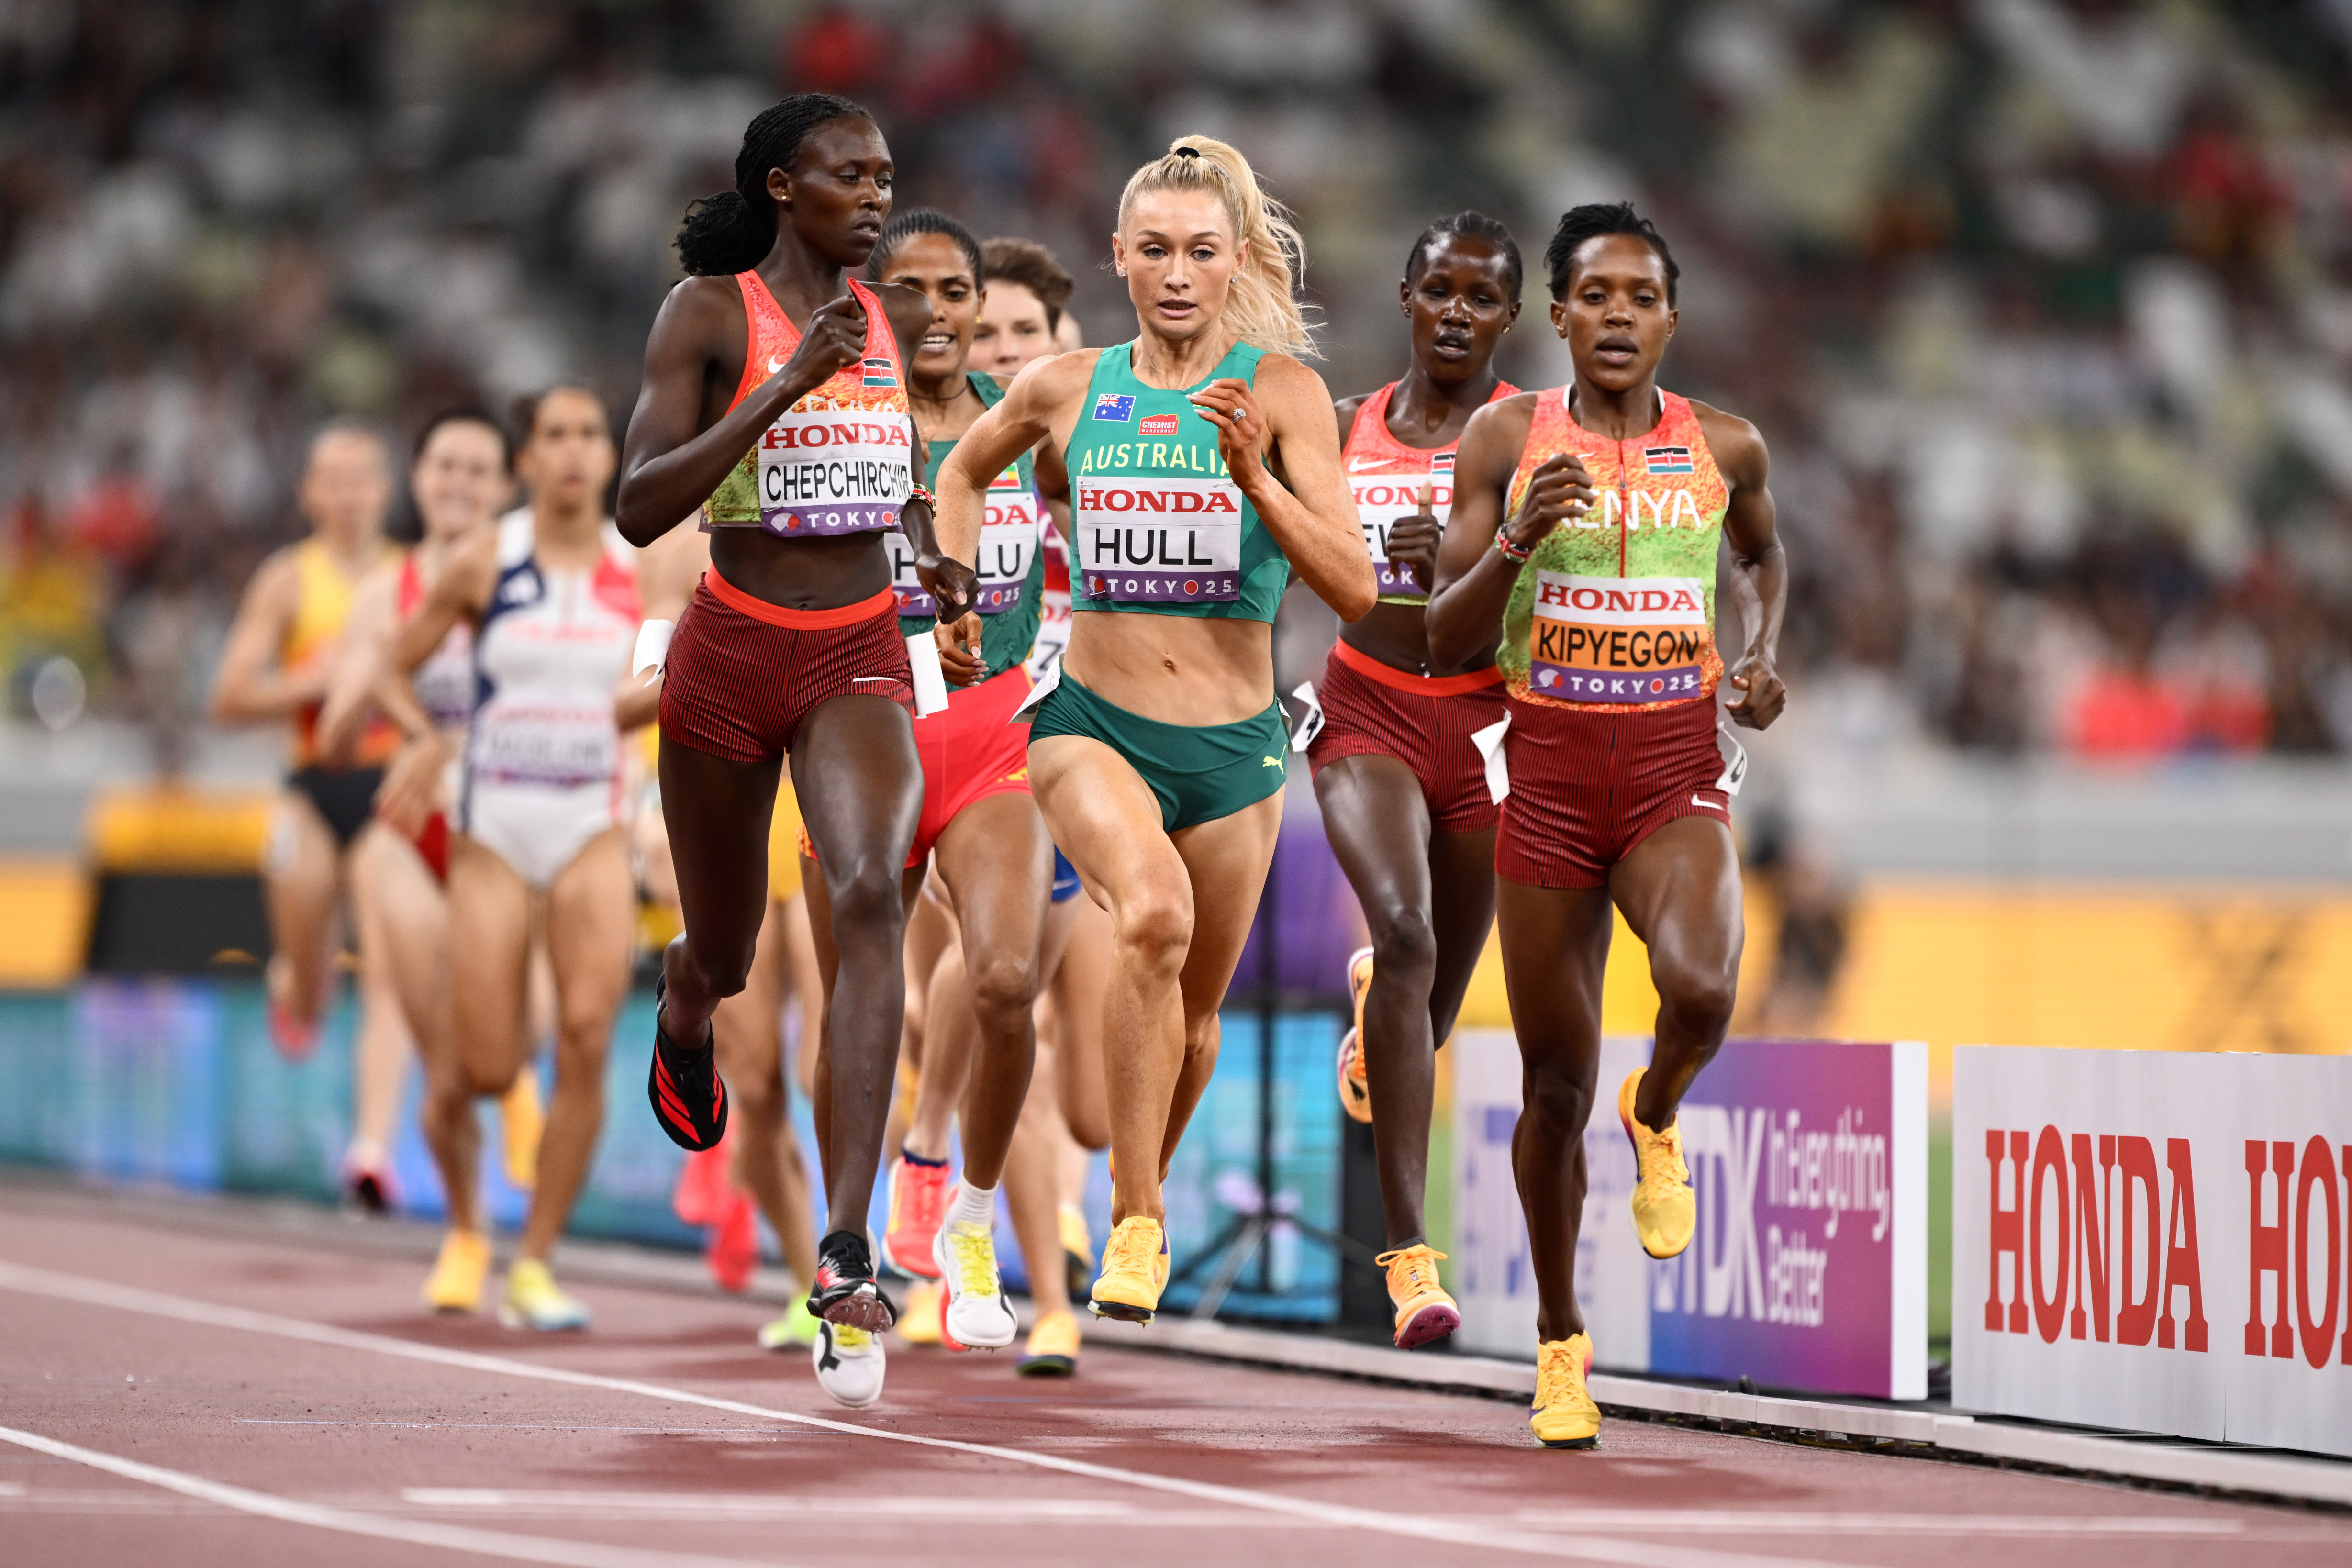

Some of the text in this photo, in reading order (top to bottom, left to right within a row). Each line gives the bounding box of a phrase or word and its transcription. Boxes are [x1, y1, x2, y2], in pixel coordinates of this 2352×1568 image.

[762, 423, 909, 449] HONDA
[1142, 421, 1177, 429] CHEMIST
[766, 461, 909, 502] CHEPCHIRCHIR
[1079, 489, 1238, 513] HONDA
[1095, 528, 1213, 565] HULL
[894, 543, 1021, 581] HLU
[1005, 587, 1020, 602] 25
[1205, 579, 1232, 594] 25
[1538, 583, 1700, 612] HONDA
[1538, 623, 1699, 667] KIPYEGON
[1669, 674, 1694, 692] 25
[1984, 1124, 2352, 1370] HONDA HO
[1767, 1223, 1827, 1327] Better
